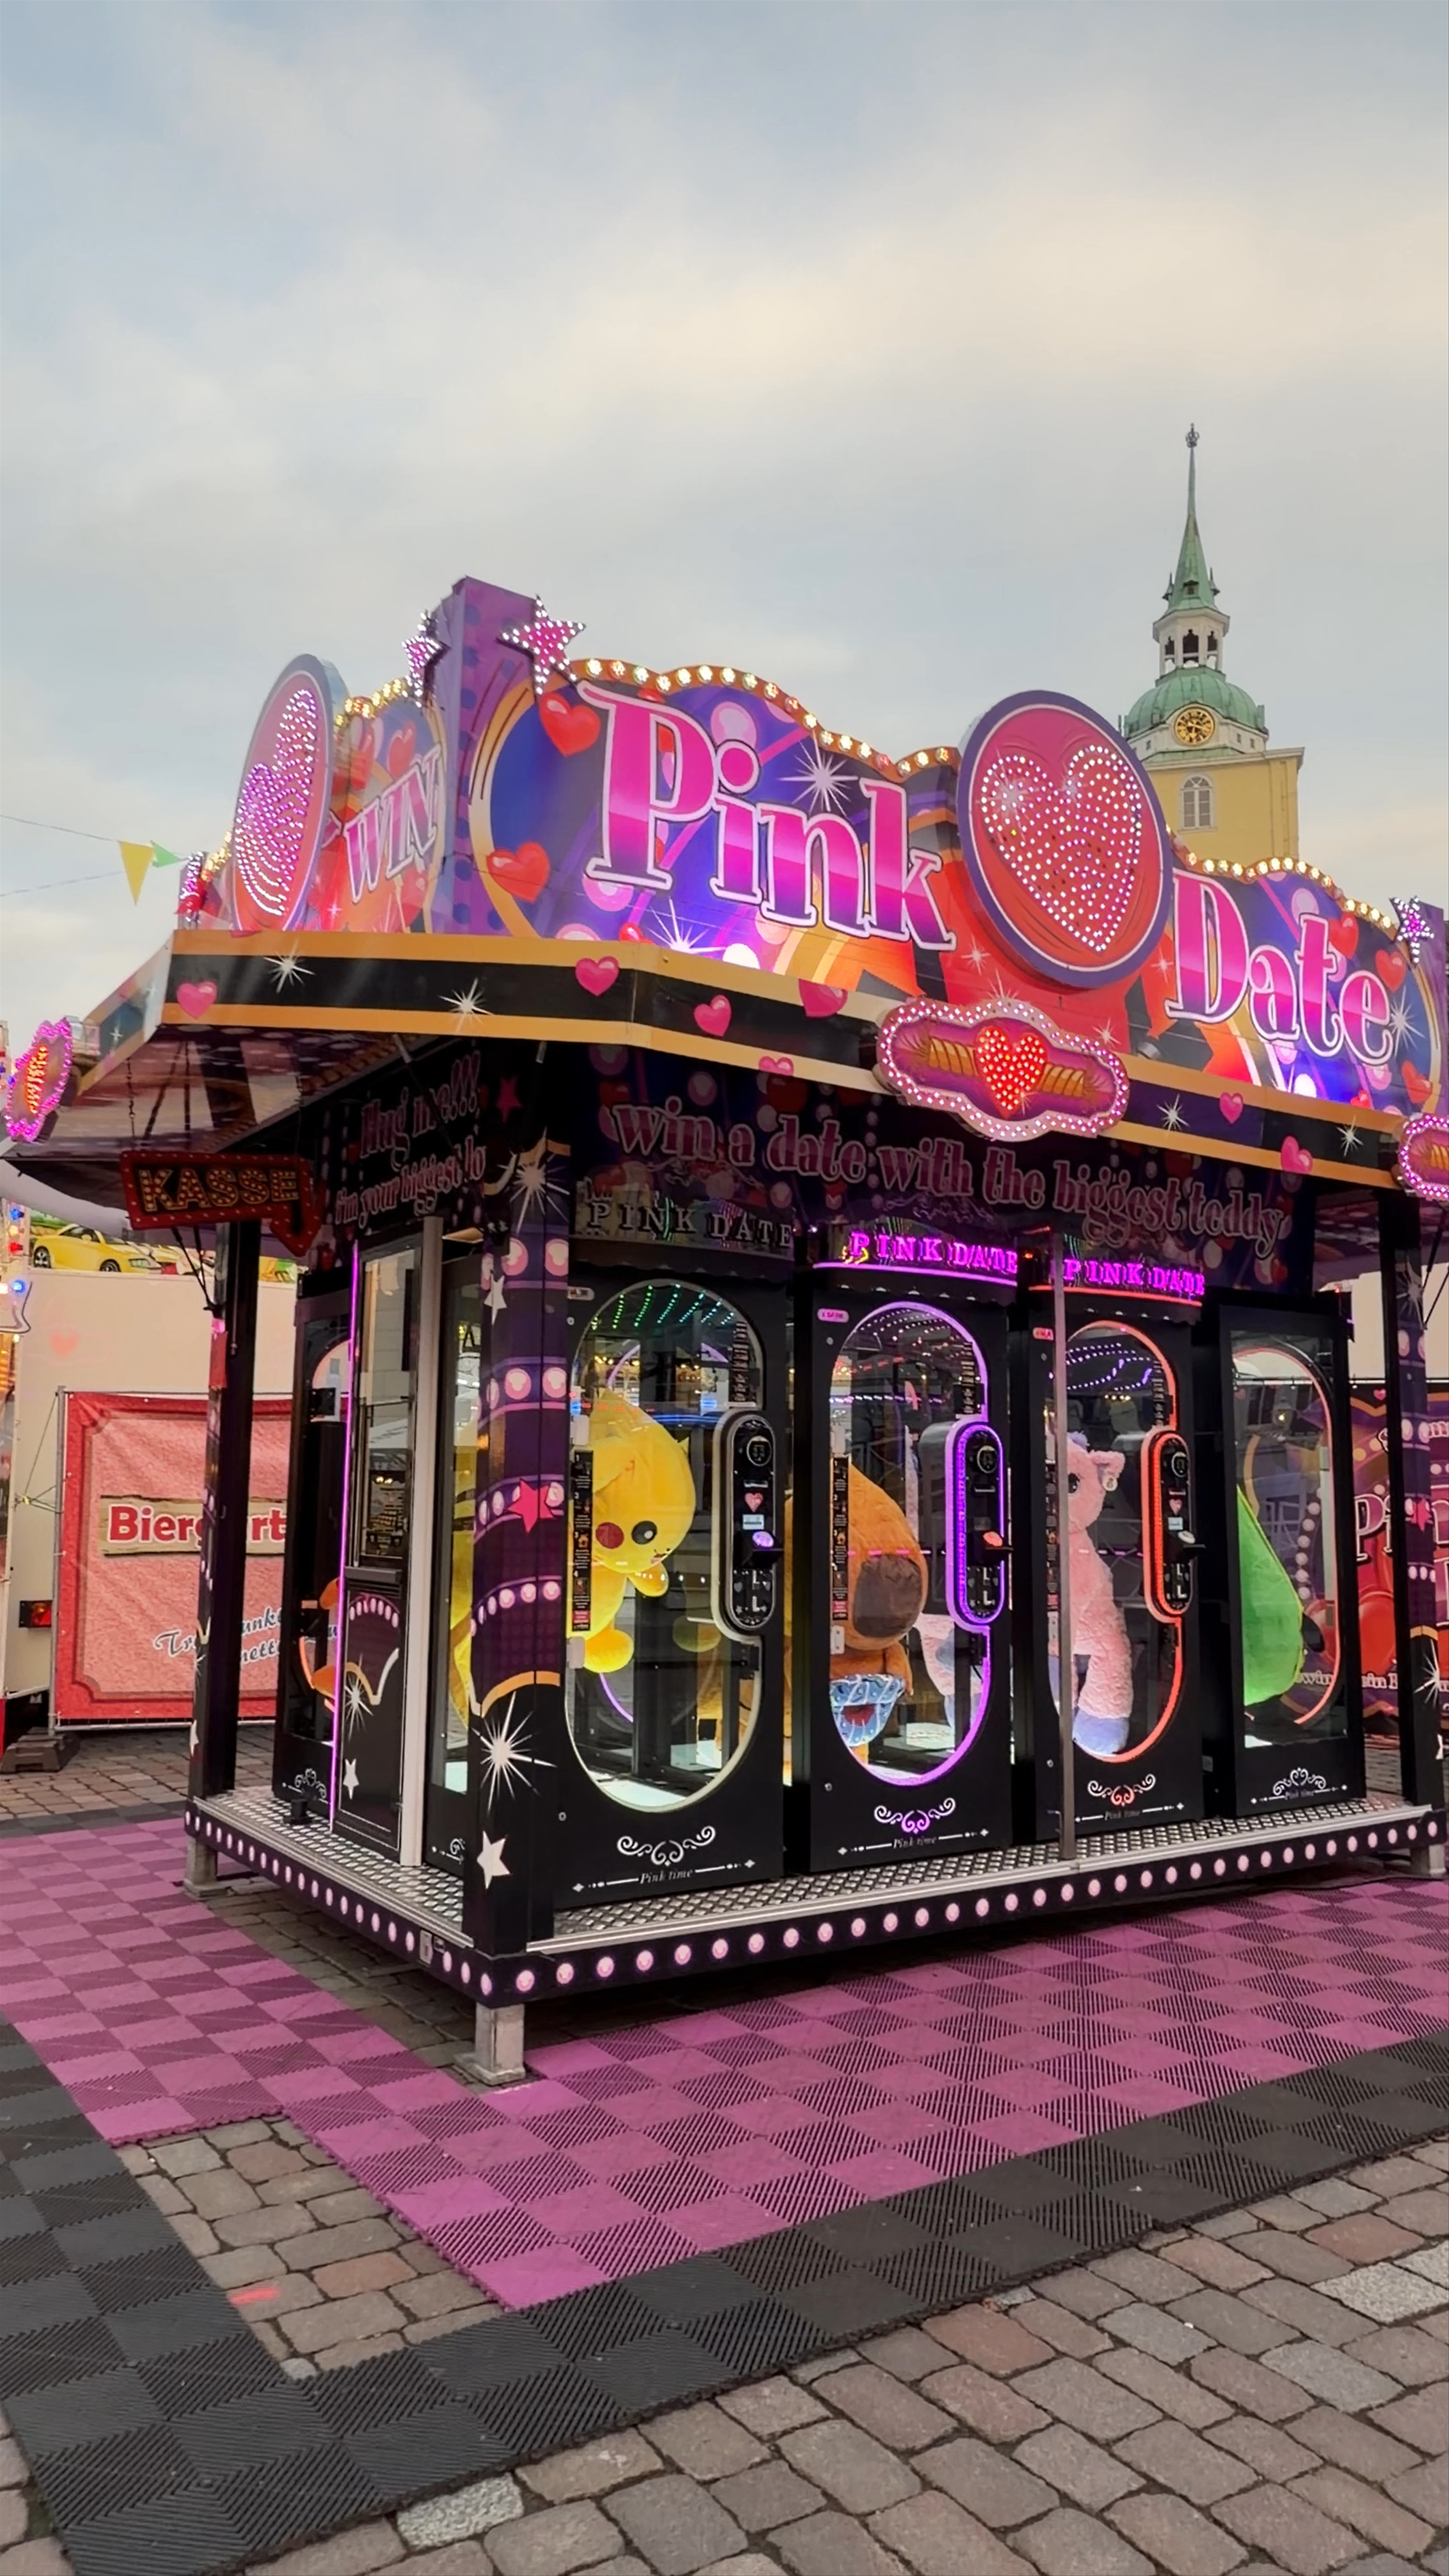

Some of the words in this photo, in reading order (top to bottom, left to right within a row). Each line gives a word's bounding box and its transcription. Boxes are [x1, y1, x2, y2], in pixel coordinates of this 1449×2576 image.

[343, 743, 441, 903] WIN
[577, 680, 956, 951] Pink
[1164, 867, 1394, 1064] Date
[138, 1168, 300, 1212] KASSE
[612, 1095, 718, 1163] win
[728, 1123, 755, 1167] a
[766, 1113, 867, 1183] date
[877, 1137, 974, 1198] with
[982, 1146, 1046, 1209] the
[1052, 1160, 1181, 1249] biggest
[1188, 1181, 1284, 1258] teddy
[590, 1201, 697, 1234] PINK
[711, 1212, 792, 1246] DATE
[850, 1232, 943, 1261] PINK
[953, 1242, 1018, 1274] DATE
[1063, 1259, 1143, 1284] PINK
[1152, 1267, 1205, 1295] DATE
[640, 1870, 666, 1884] Pink
